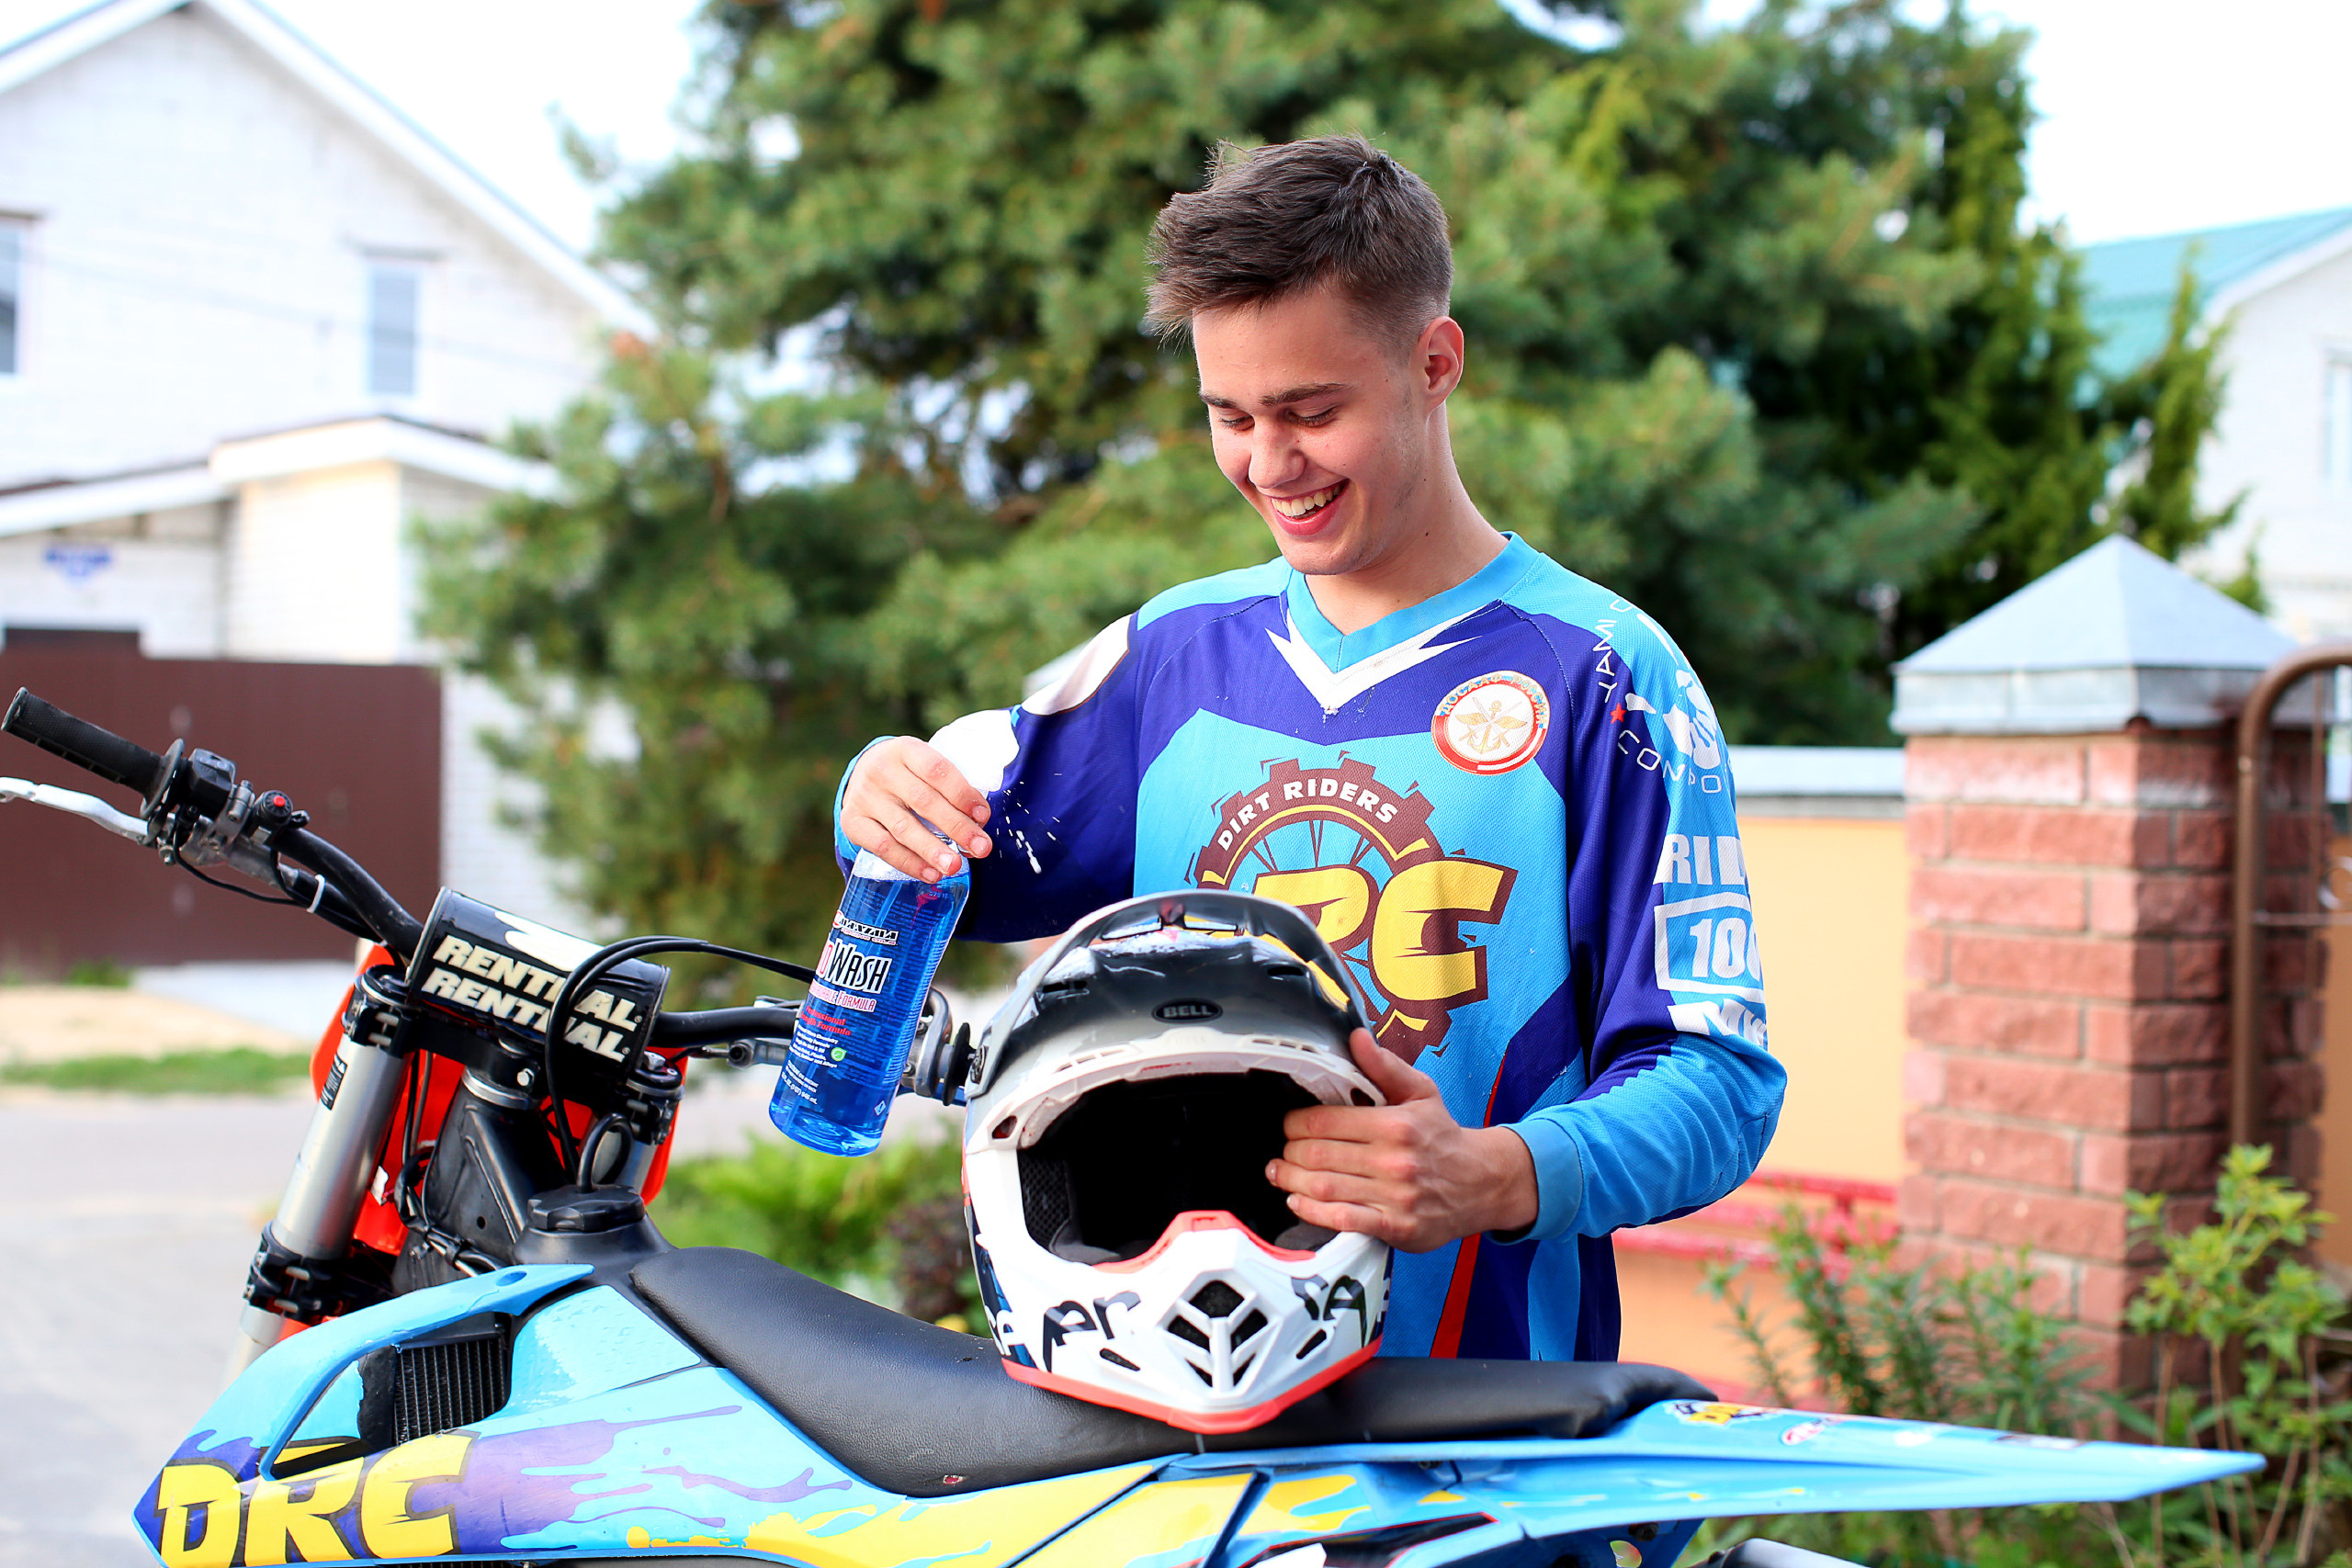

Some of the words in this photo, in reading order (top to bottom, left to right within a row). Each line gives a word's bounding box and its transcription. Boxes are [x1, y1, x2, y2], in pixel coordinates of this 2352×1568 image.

[1217, 793, 1270, 851] DIRT
[1283, 778, 1398, 823] RIDERS
[817, 1021, 852, 1036] Formula
[1163, 1004, 1212, 1019] BELL
[158, 1434, 472, 1568] DRC
